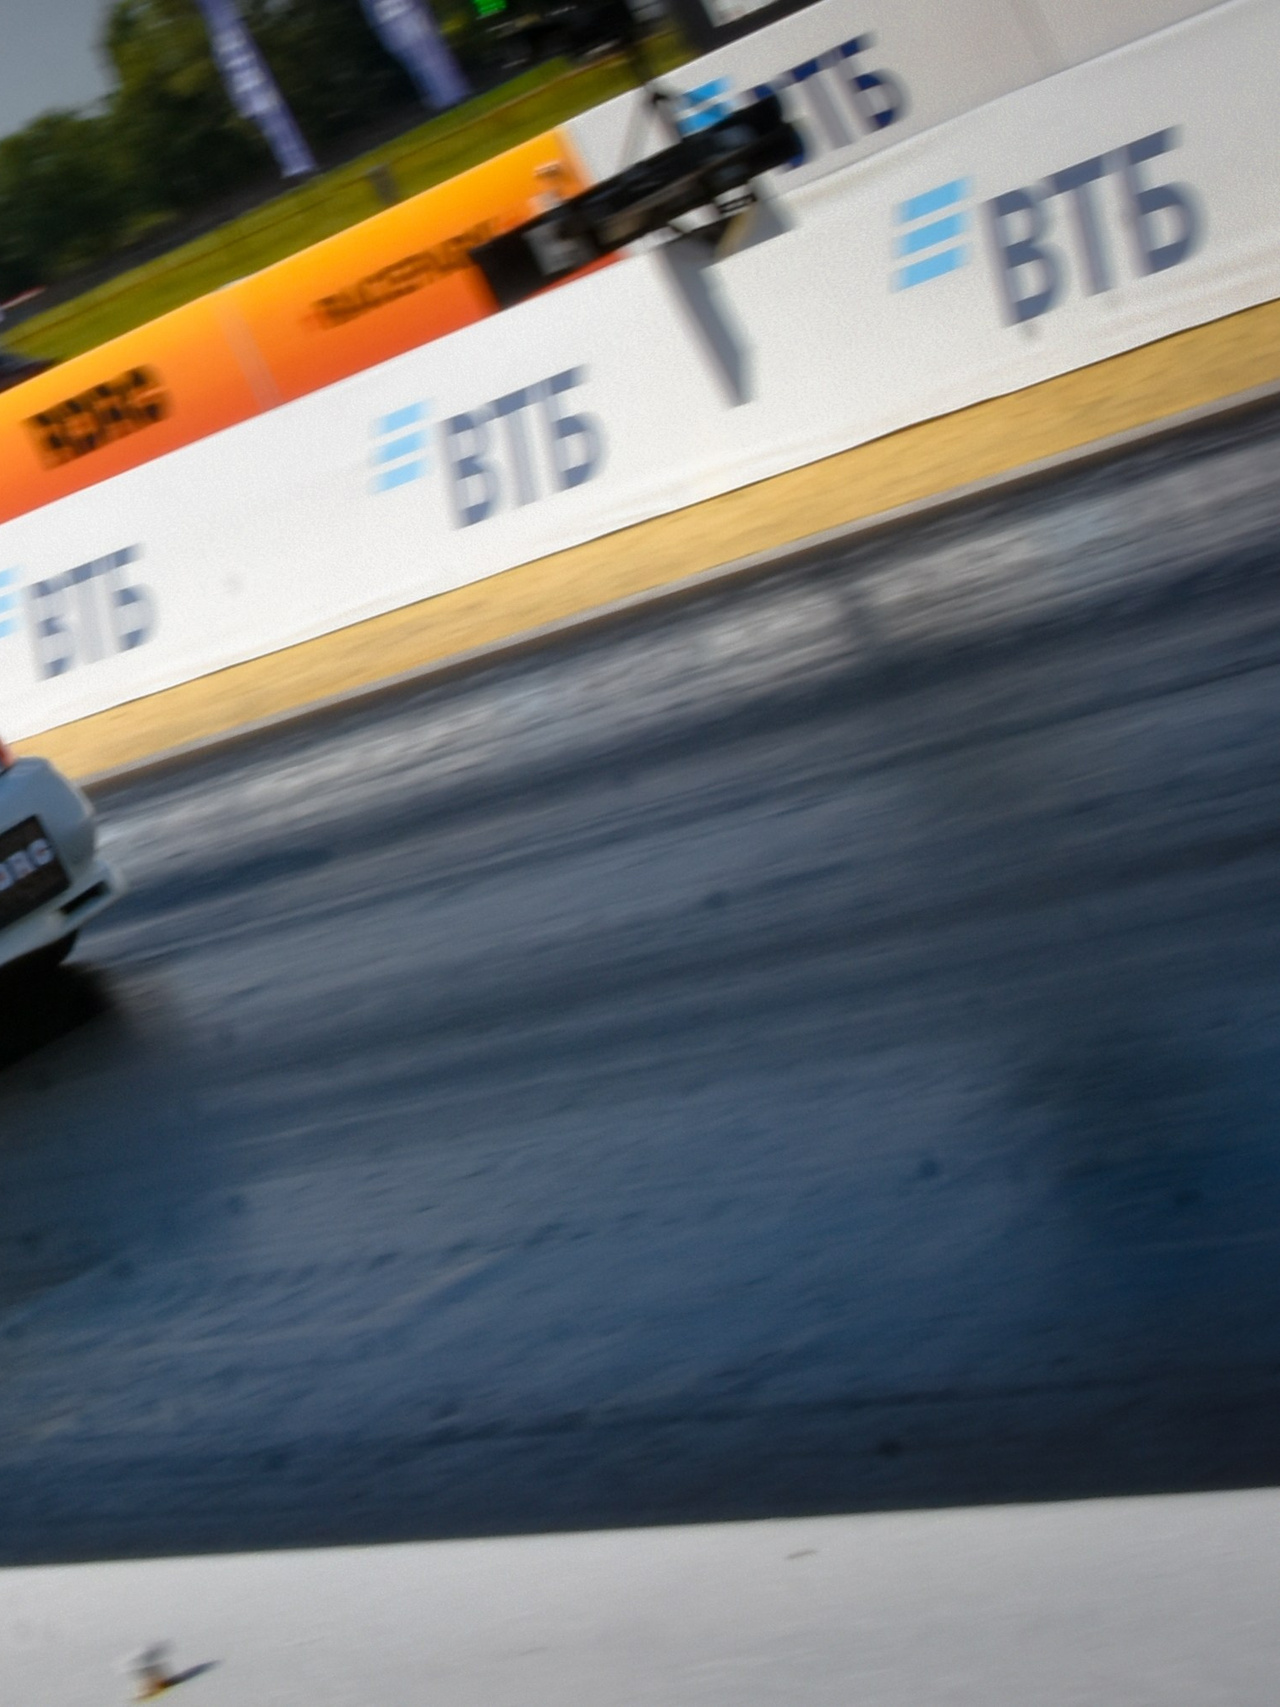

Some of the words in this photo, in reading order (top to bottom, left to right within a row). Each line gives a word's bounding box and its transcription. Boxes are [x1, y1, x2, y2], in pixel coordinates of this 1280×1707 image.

[984, 124, 1208, 327] ВТБ
[438, 364, 609, 529] ВТБ
[21, 543, 160, 682] ВТБ
